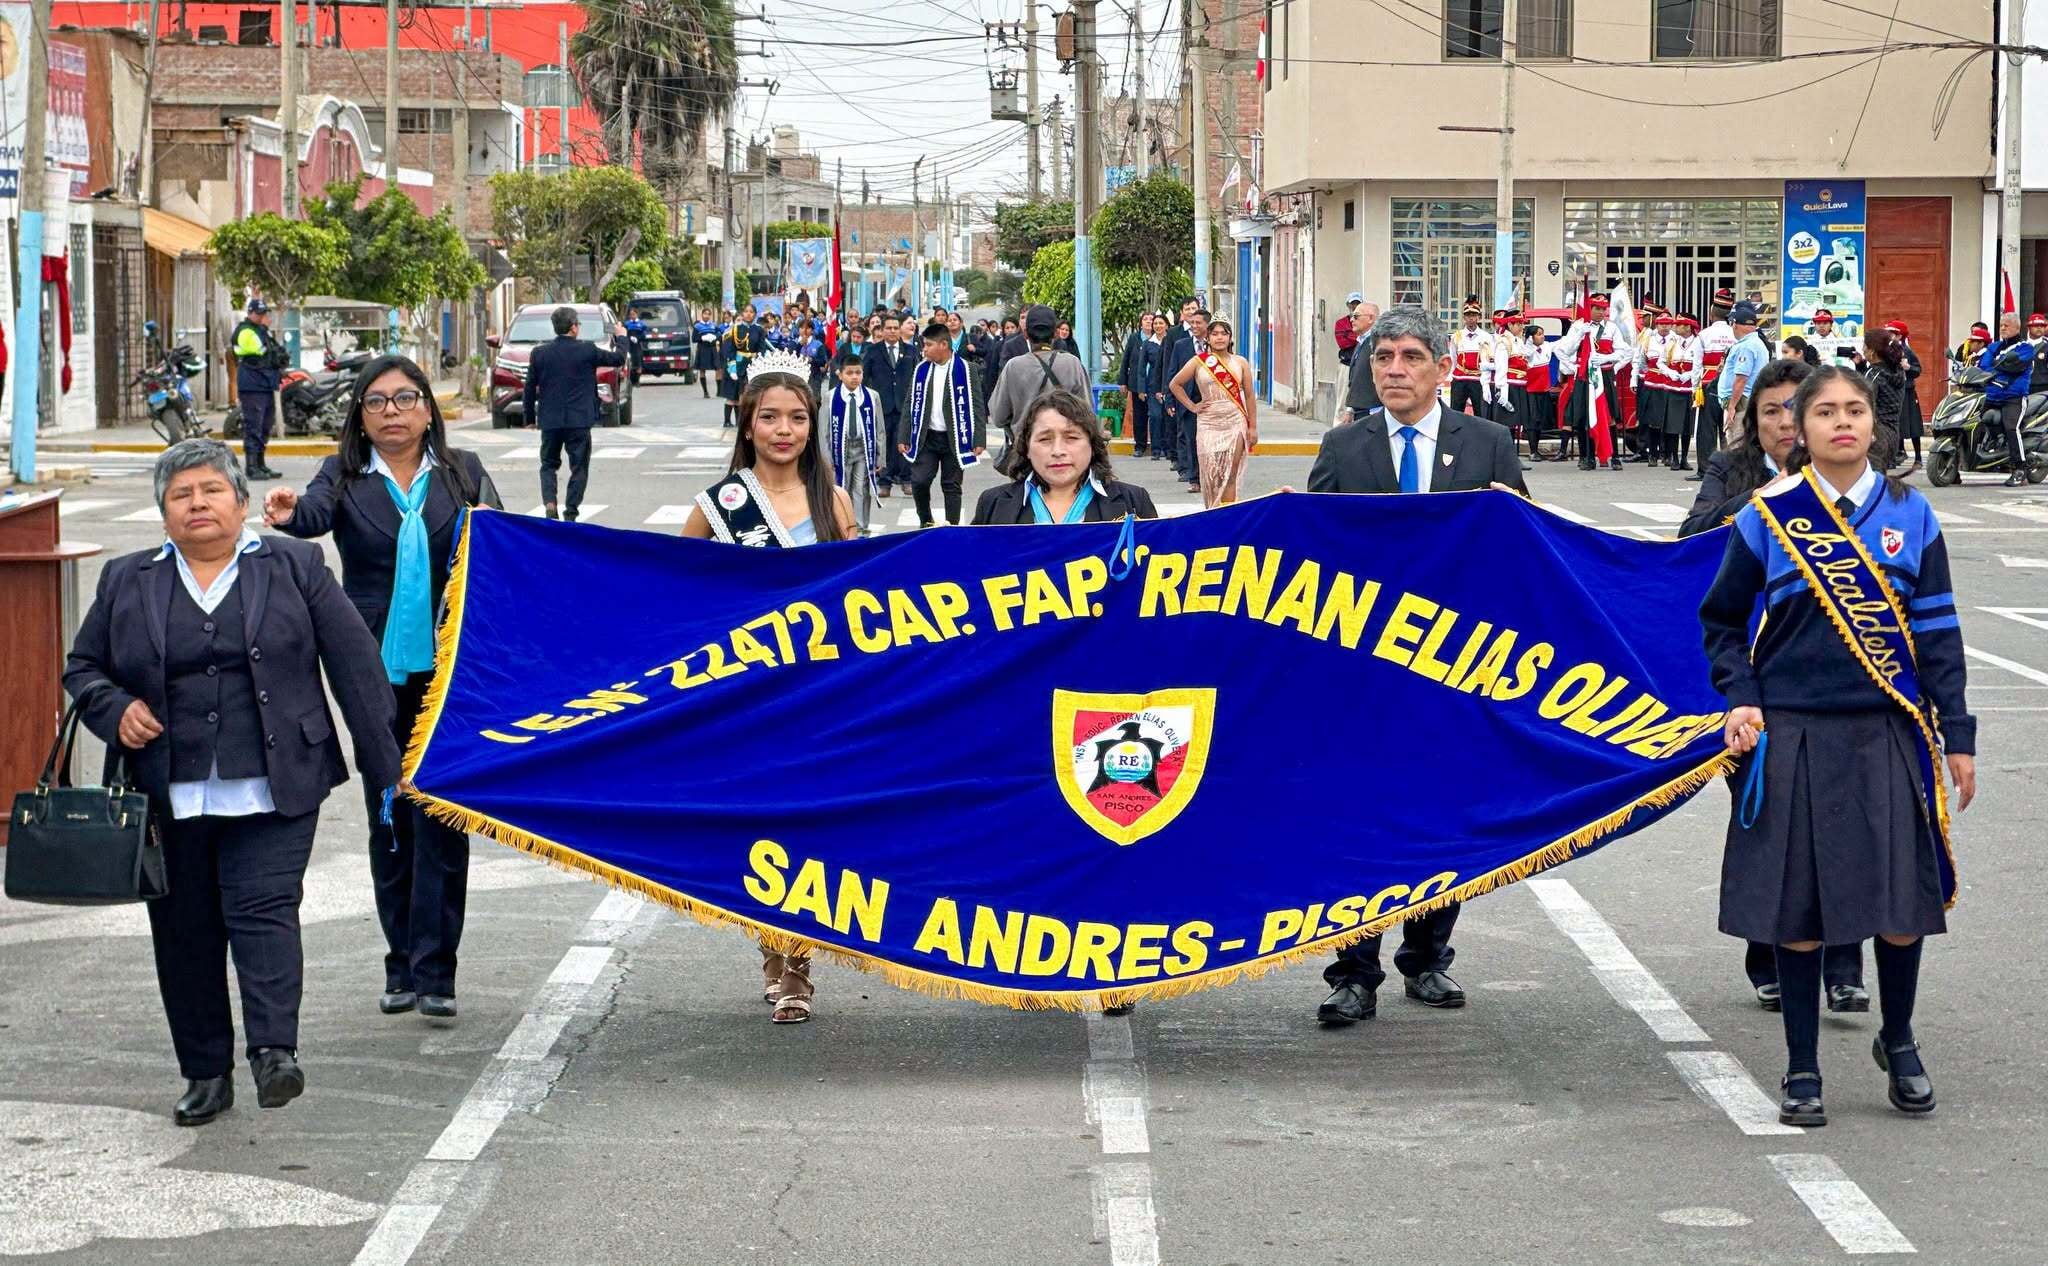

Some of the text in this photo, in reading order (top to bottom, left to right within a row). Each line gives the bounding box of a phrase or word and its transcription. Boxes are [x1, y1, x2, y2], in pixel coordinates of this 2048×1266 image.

[1803, 202, 1848, 212] QuickLava
[1793, 237, 1813, 250] 3x2
[913, 382, 922, 435] MISTER
[956, 386, 968, 445] TALENTO
[1785, 517, 1904, 687] Alcaldesa
[643, 601, 841, 690] 22472
[843, 581, 977, 654] CAP.
[981, 555, 1108, 632] FAP.
[1371, 591, 1556, 701] ELIAS
[1142, 712, 1166, 729] ELIAS
[1118, 755, 1140, 767] RE
[1104, 801, 1145, 812] PISCO
[743, 839, 890, 943] SAN
